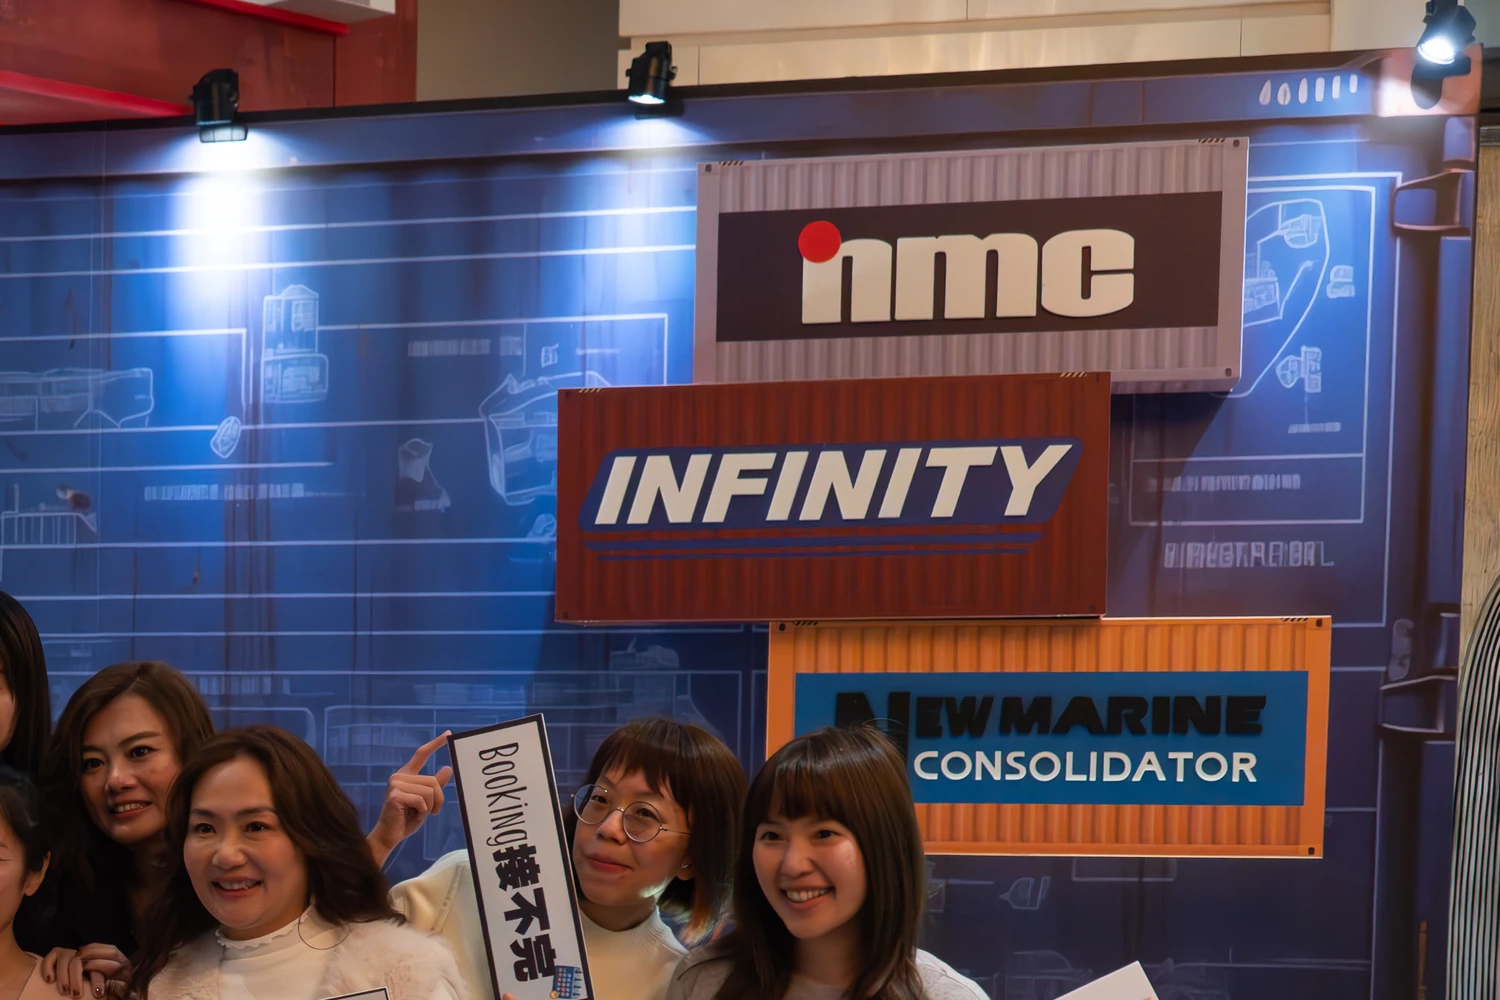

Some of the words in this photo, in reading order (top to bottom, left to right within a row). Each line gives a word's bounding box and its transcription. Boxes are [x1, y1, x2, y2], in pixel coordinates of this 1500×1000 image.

[594, 444, 1073, 524] INFINITY
[836, 691, 995, 769] NEW
[999, 695, 1267, 736] MARINE
[913, 750, 1258, 783] CONSOLIDATOR
